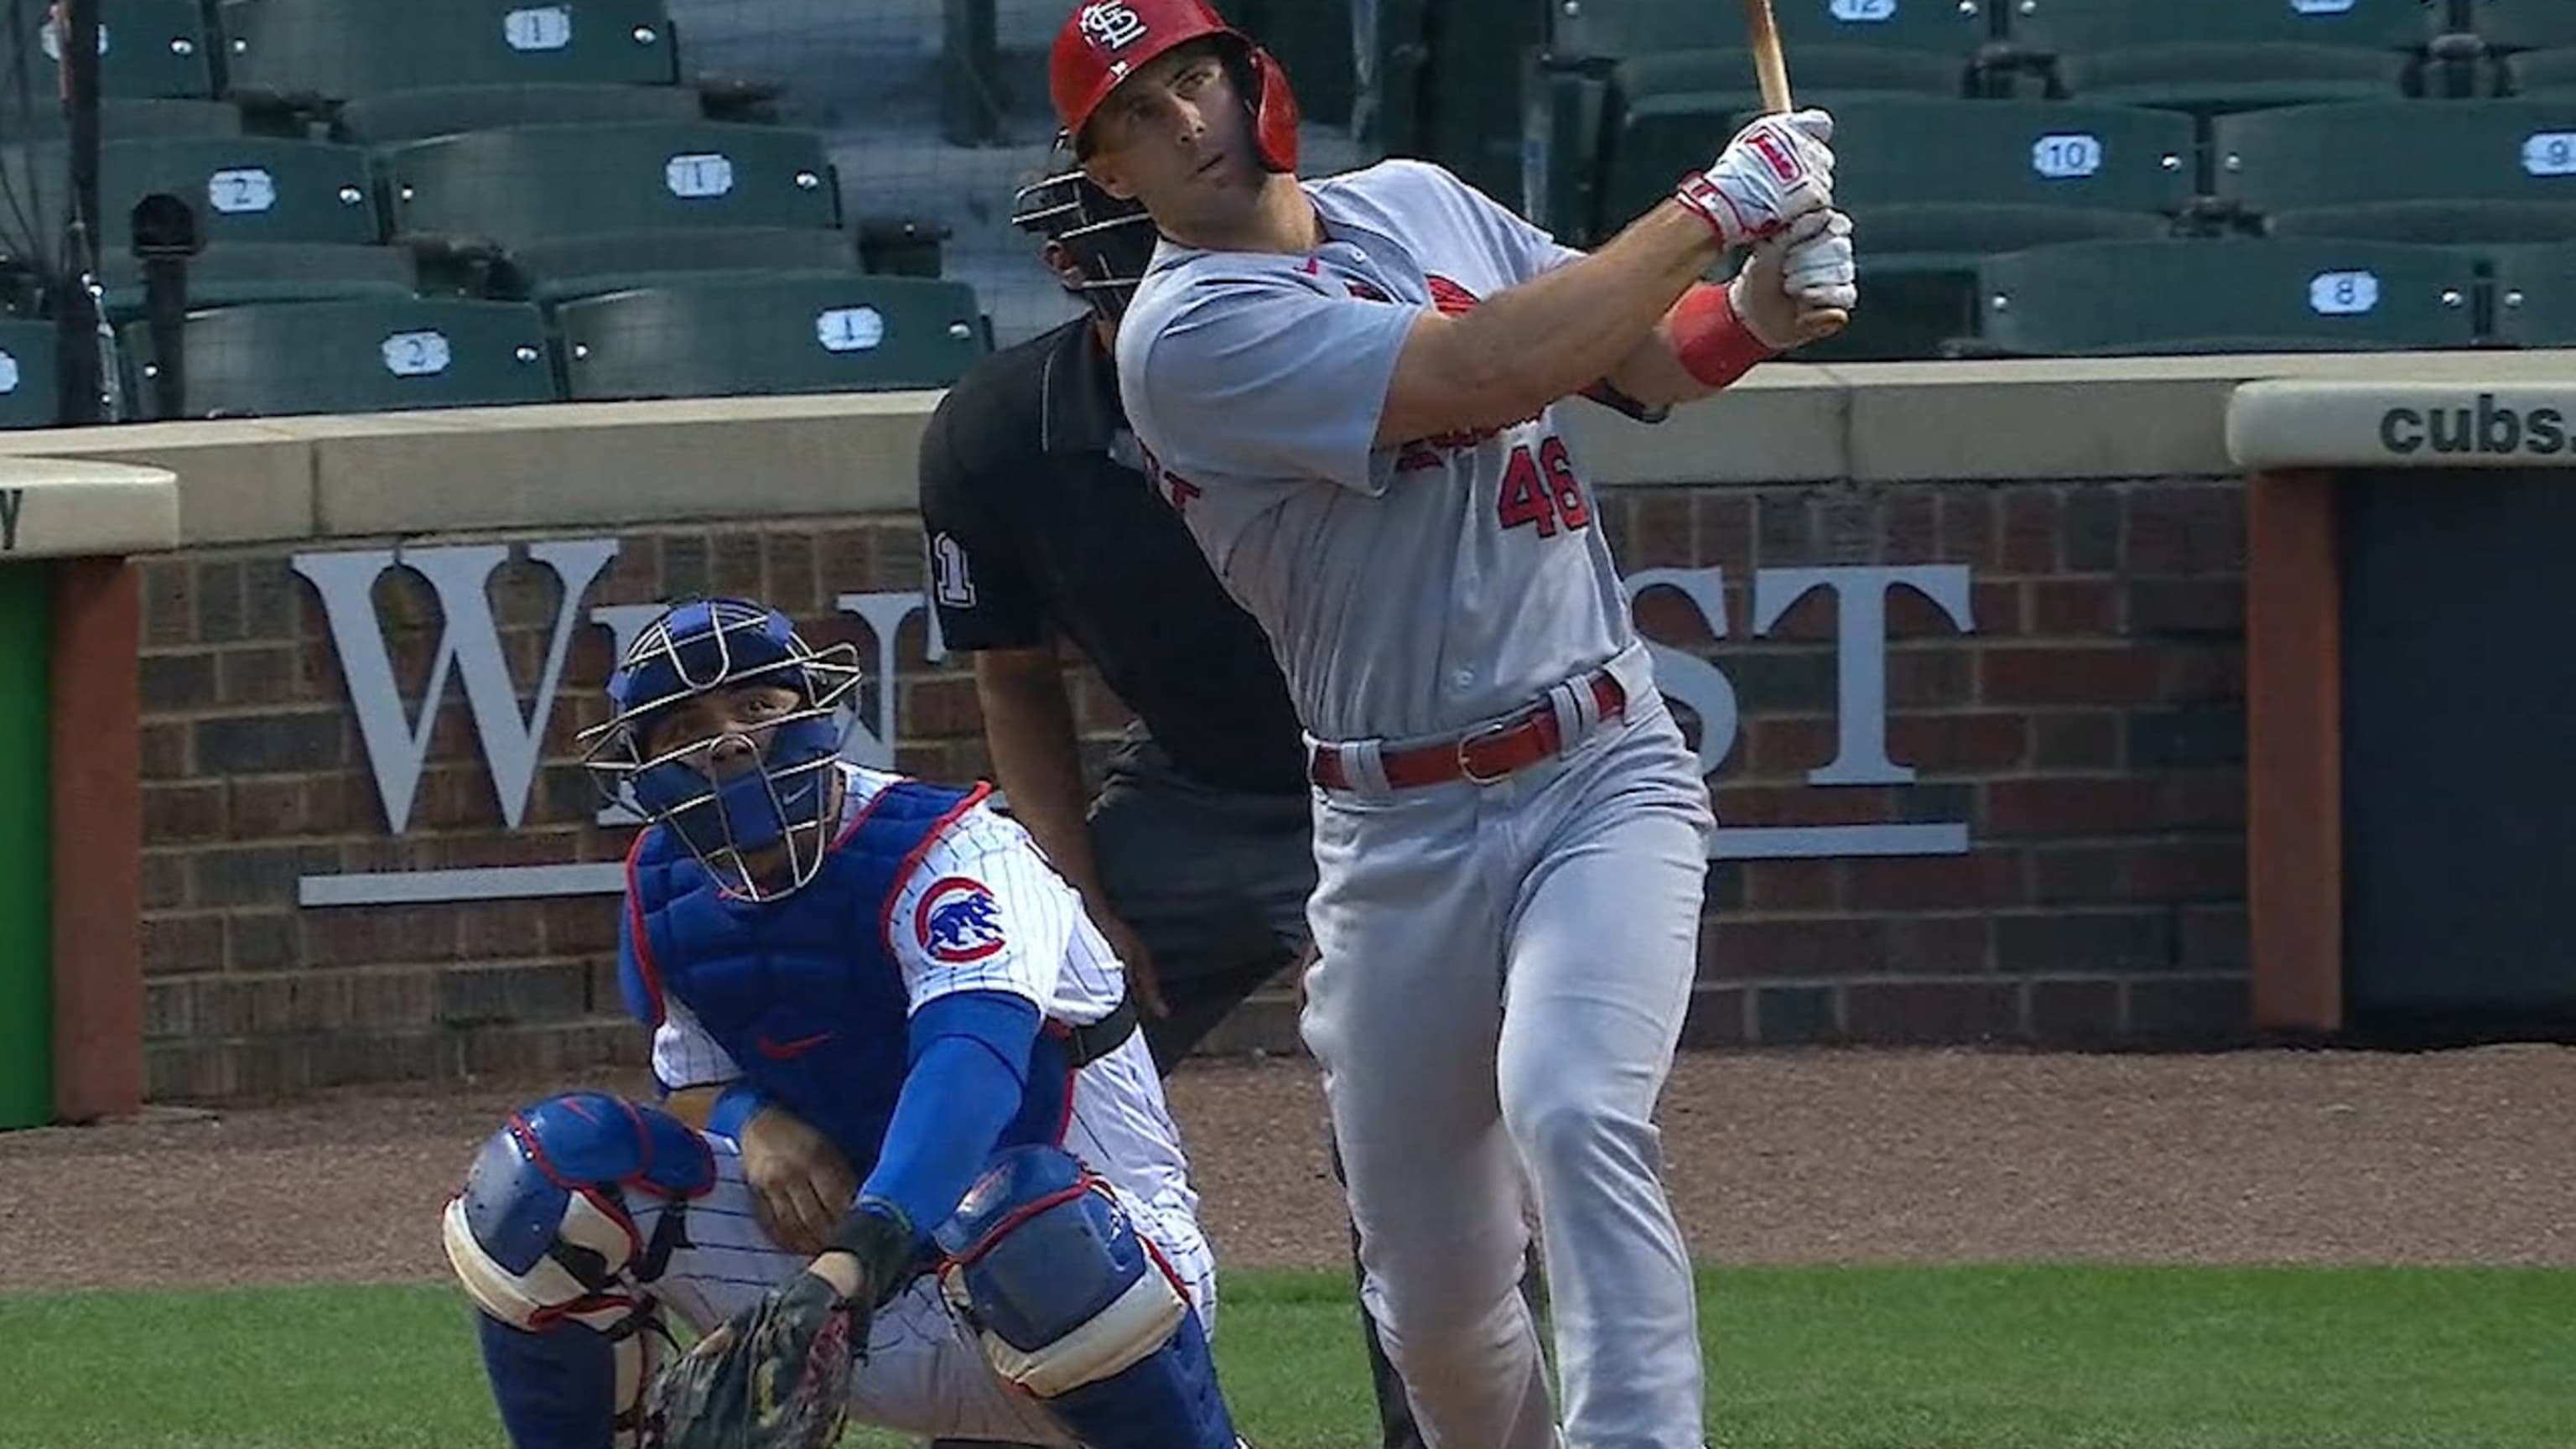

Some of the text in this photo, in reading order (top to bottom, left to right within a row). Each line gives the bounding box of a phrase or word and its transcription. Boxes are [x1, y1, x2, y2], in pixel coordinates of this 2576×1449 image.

[2050, 142, 2086, 167] 10
[2547, 140, 2569, 166] 9
[232, 178, 250, 204] 2
[2334, 278, 2355, 305] 8
[1498, 436, 1590, 538] 46
[934, 532, 977, 609] 1
